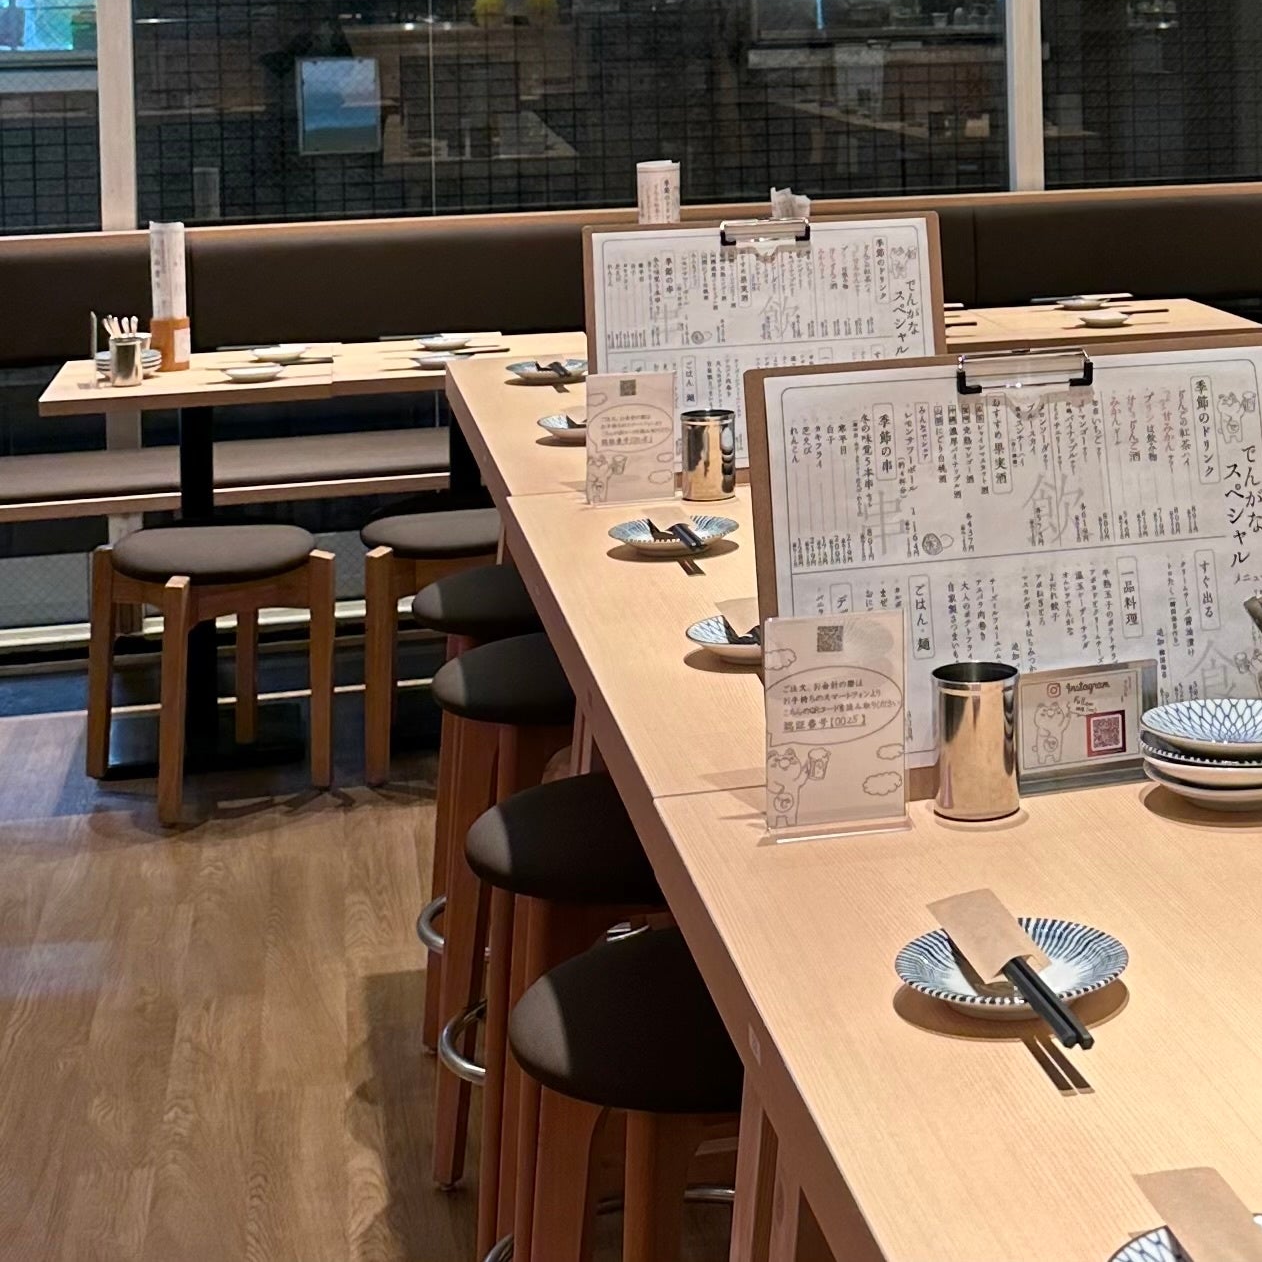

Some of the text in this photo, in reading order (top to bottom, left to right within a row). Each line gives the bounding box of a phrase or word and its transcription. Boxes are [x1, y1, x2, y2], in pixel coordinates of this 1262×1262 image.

[893, 291, 909, 356] スペシャル
[905, 279, 920, 335] でんがな
[879, 414, 892, 473] 季節の串
[992, 398, 1007, 484] おすすめ果実酒
[1195, 380, 1215, 477] 季節のドリンク
[1224, 463, 1250, 567] スペシャル
[1120, 570, 1139, 626] 一品料理
[1200, 560, 1214, 618] すぐ出る
[1066, 681, 1110, 694] Instagram
